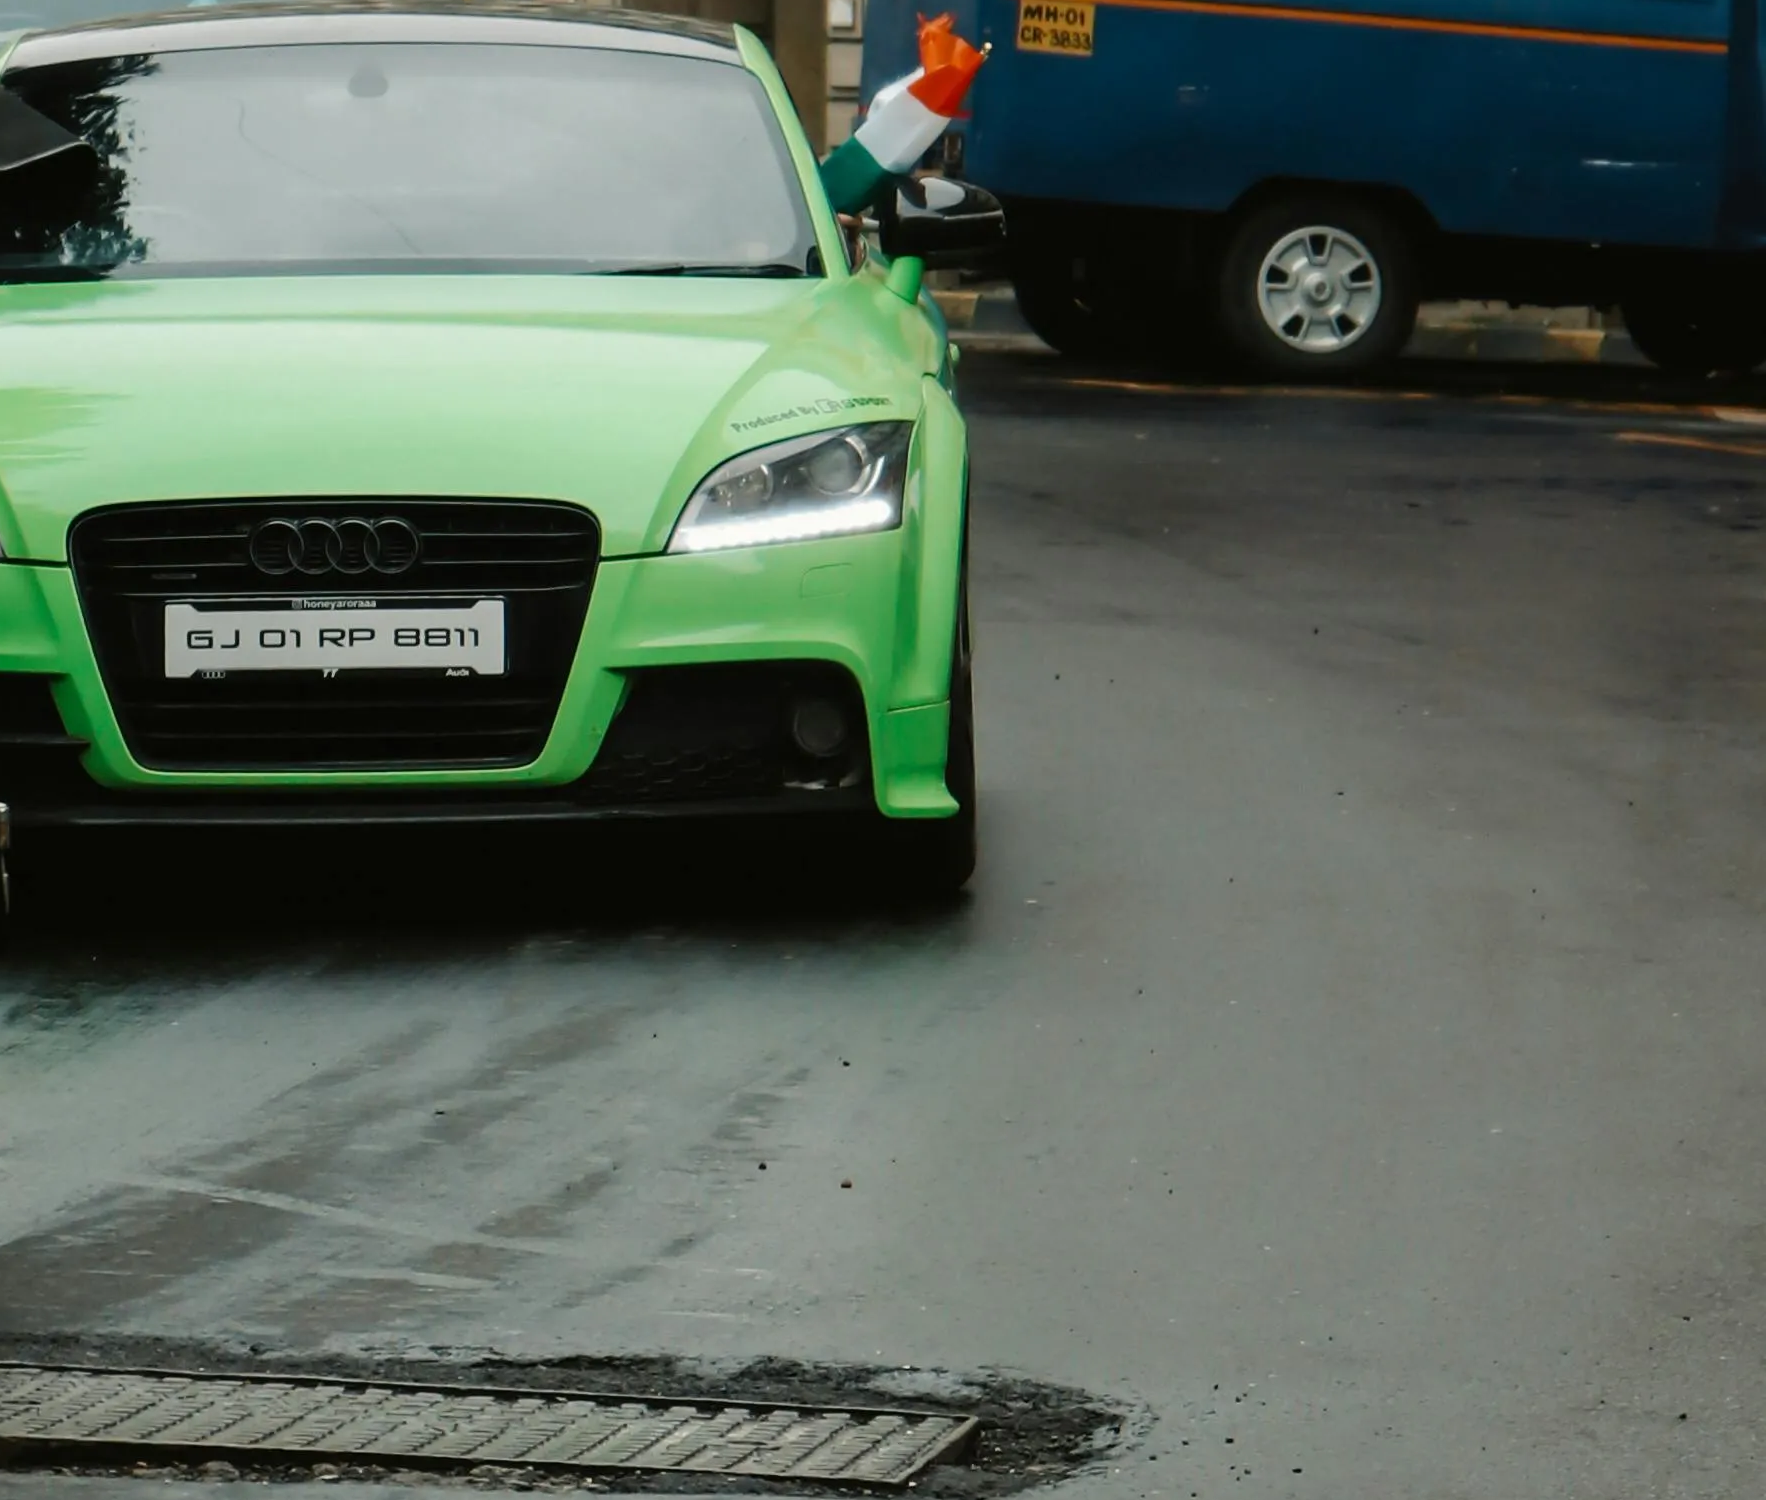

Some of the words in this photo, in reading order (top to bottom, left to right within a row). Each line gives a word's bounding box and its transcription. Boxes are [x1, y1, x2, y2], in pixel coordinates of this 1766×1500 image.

[730, 408, 800, 433] Produced
[186, 629, 240, 649] GJ
[259, 629, 302, 649] 01
[319, 628, 376, 648] RP
[393, 628, 480, 648] 8811
[445, 668, 469, 678] Audi
